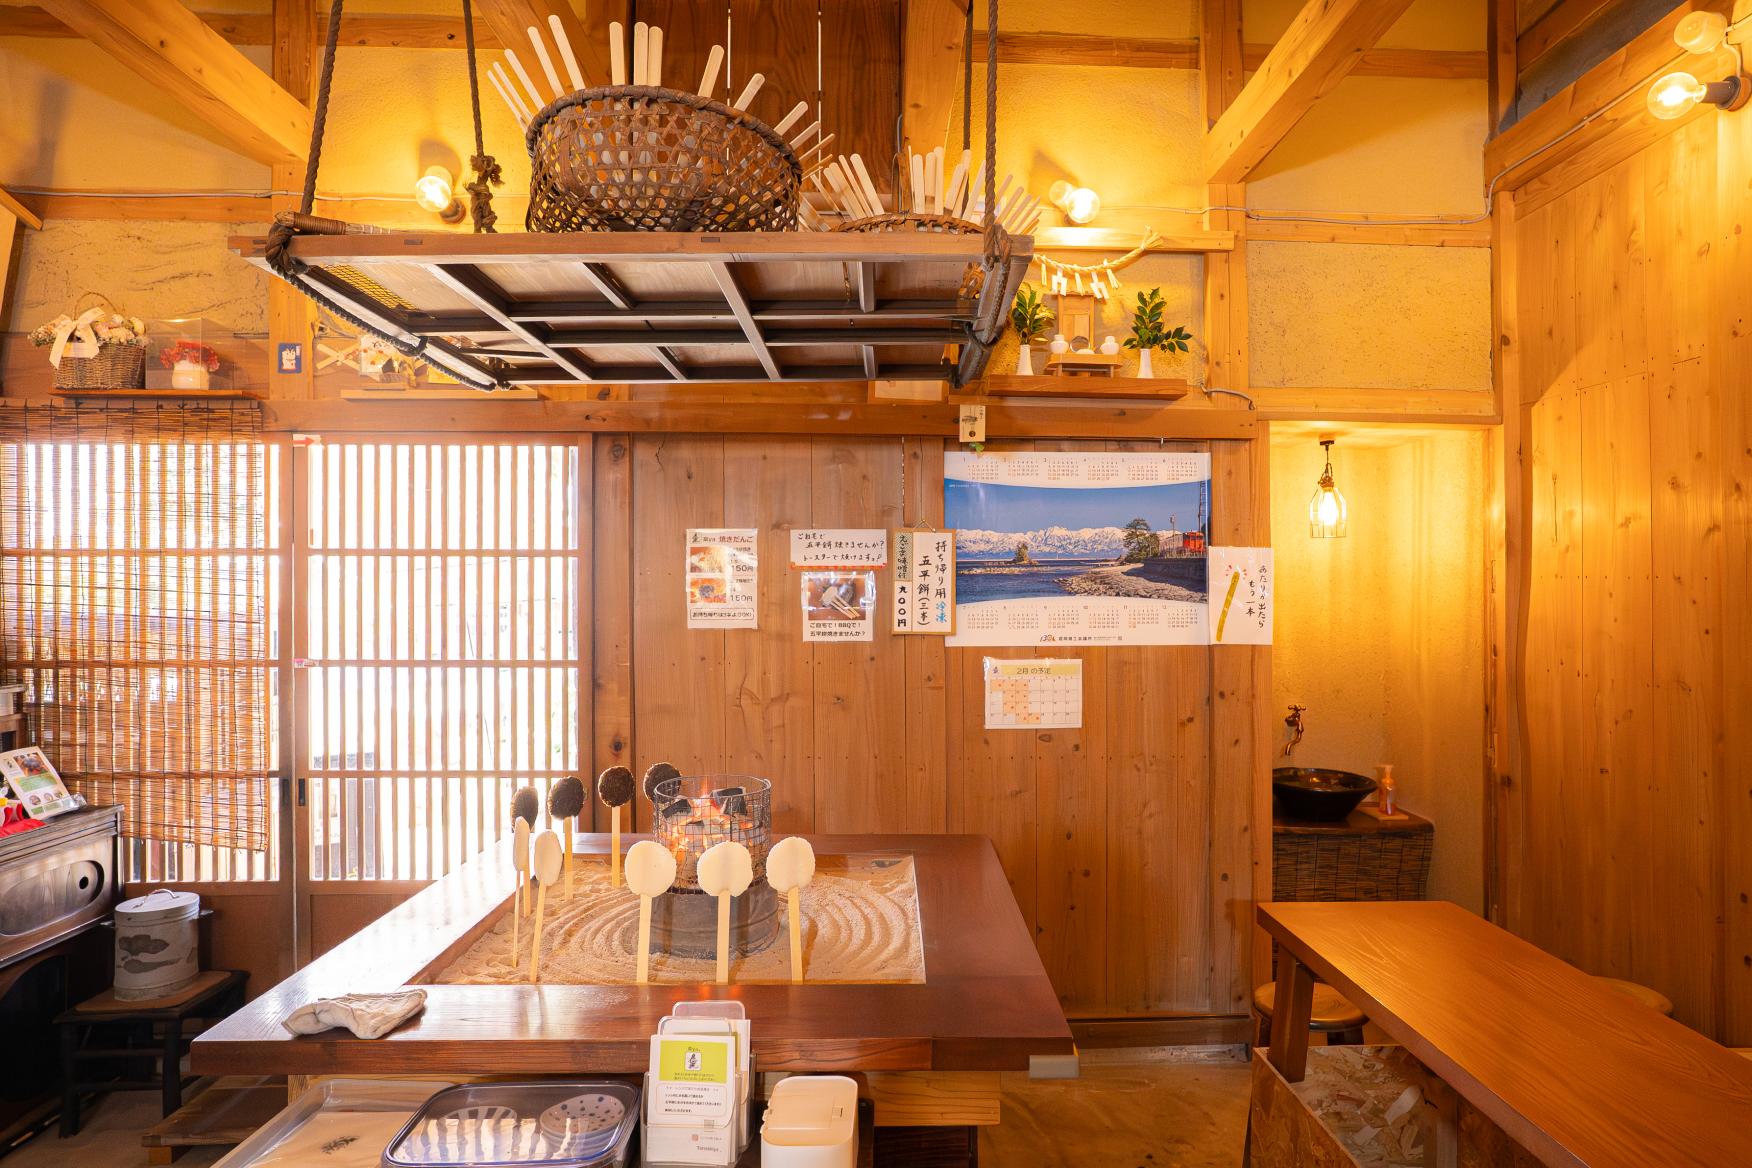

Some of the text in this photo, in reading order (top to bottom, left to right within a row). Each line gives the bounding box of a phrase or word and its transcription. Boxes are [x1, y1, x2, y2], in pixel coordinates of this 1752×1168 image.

[719, 535, 754, 544] 焼きだんご
[1245, 579, 1256, 617] もう一本
[1016, 667, 1052, 675] 2月の予定
